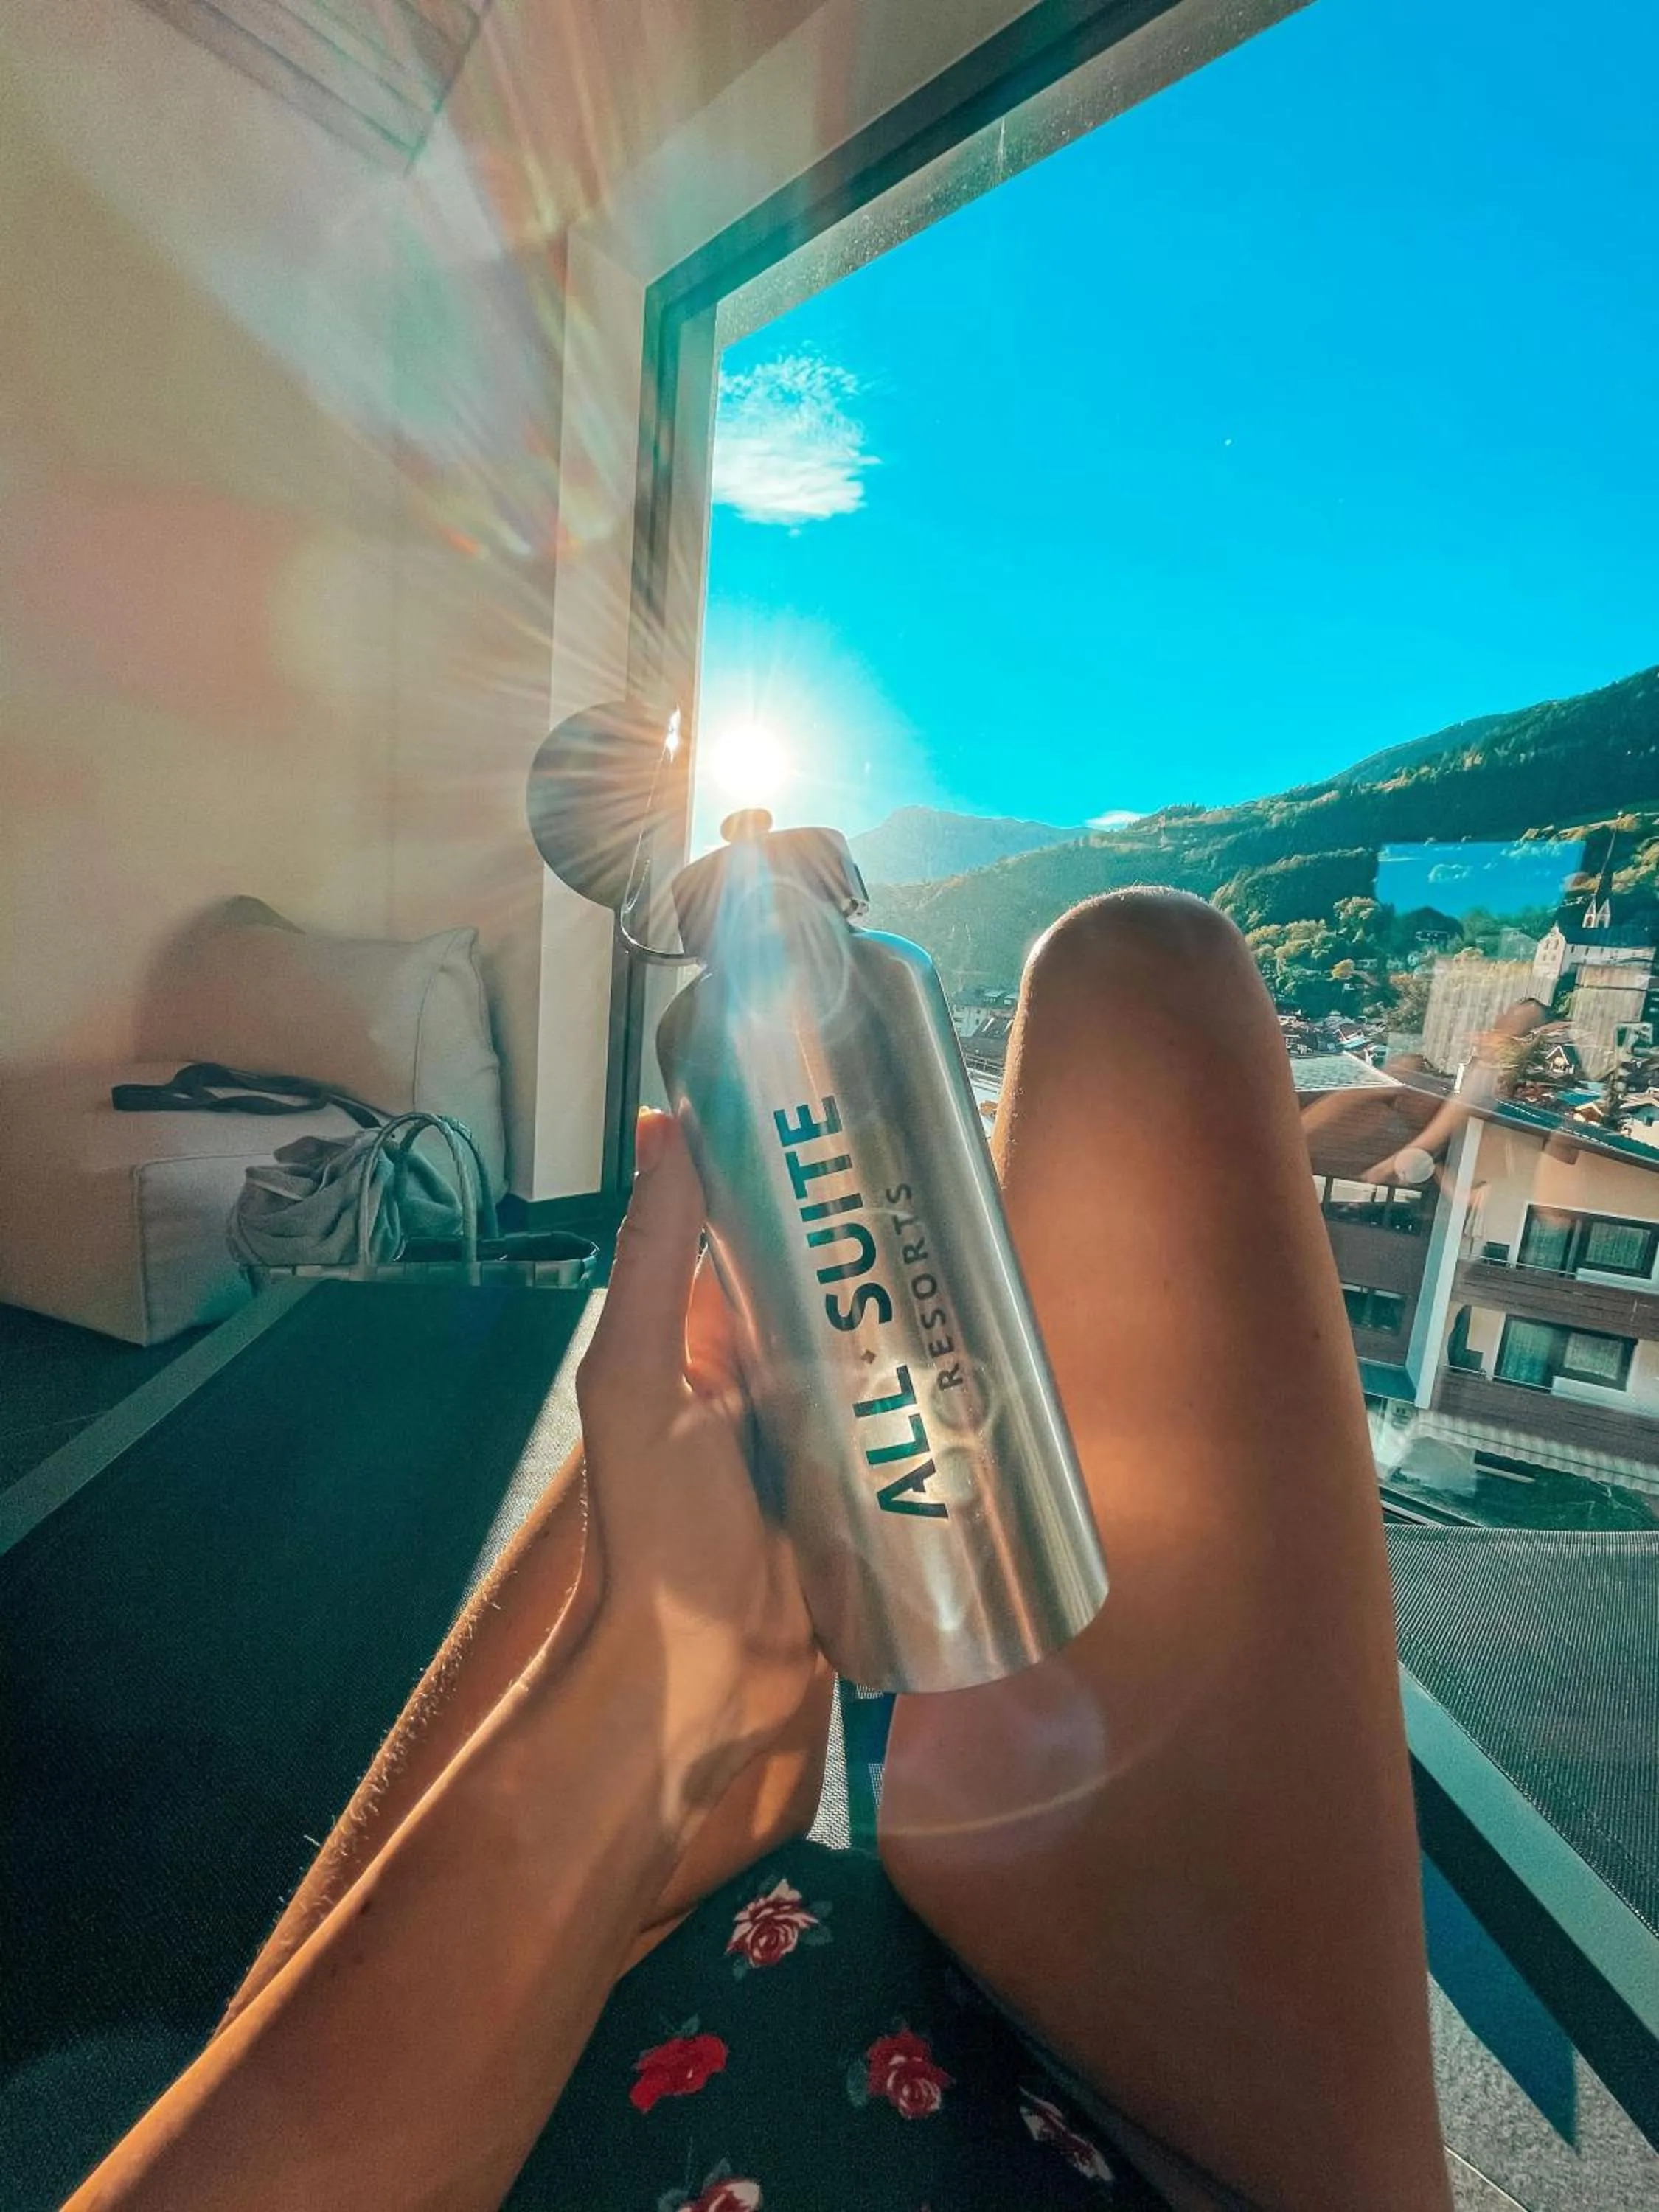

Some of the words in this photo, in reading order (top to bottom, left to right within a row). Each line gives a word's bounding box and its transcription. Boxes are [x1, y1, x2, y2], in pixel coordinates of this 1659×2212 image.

[773, 1095, 893, 1332] SUITE
[886, 1182, 964, 1391] RESORTS
[852, 1364, 949, 1520] ALL
